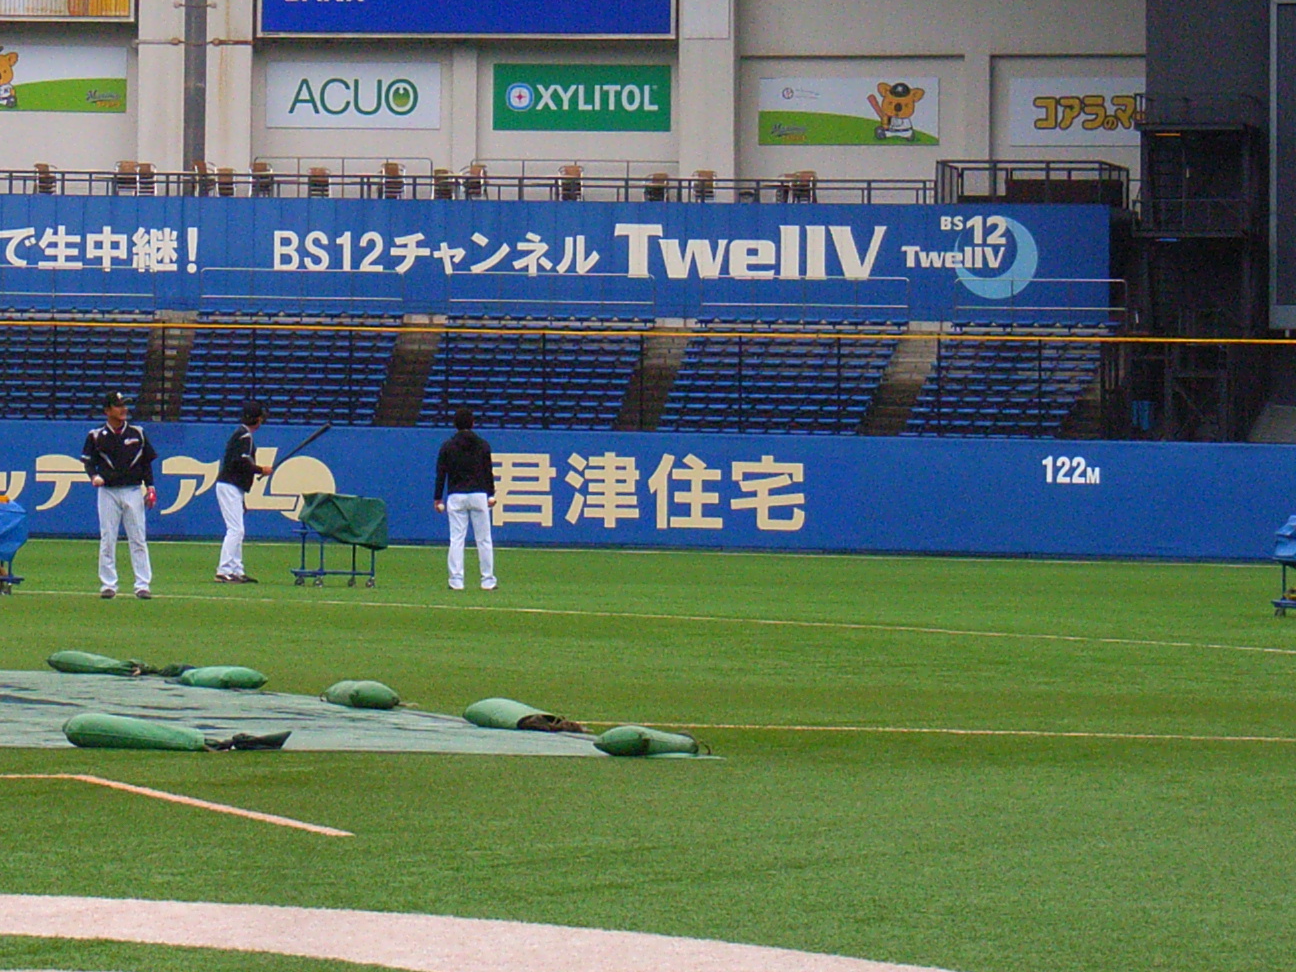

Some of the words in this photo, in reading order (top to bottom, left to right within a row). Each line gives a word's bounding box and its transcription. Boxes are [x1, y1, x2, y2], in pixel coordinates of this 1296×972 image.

[288, 78, 419, 116] ACUO
[536, 83, 658, 112] XYLITOL
[1033, 95, 1144, 130] コアラのマ
[1042, 455, 1101, 484] 122M
[490, 451, 806, 531] 君津住宅
